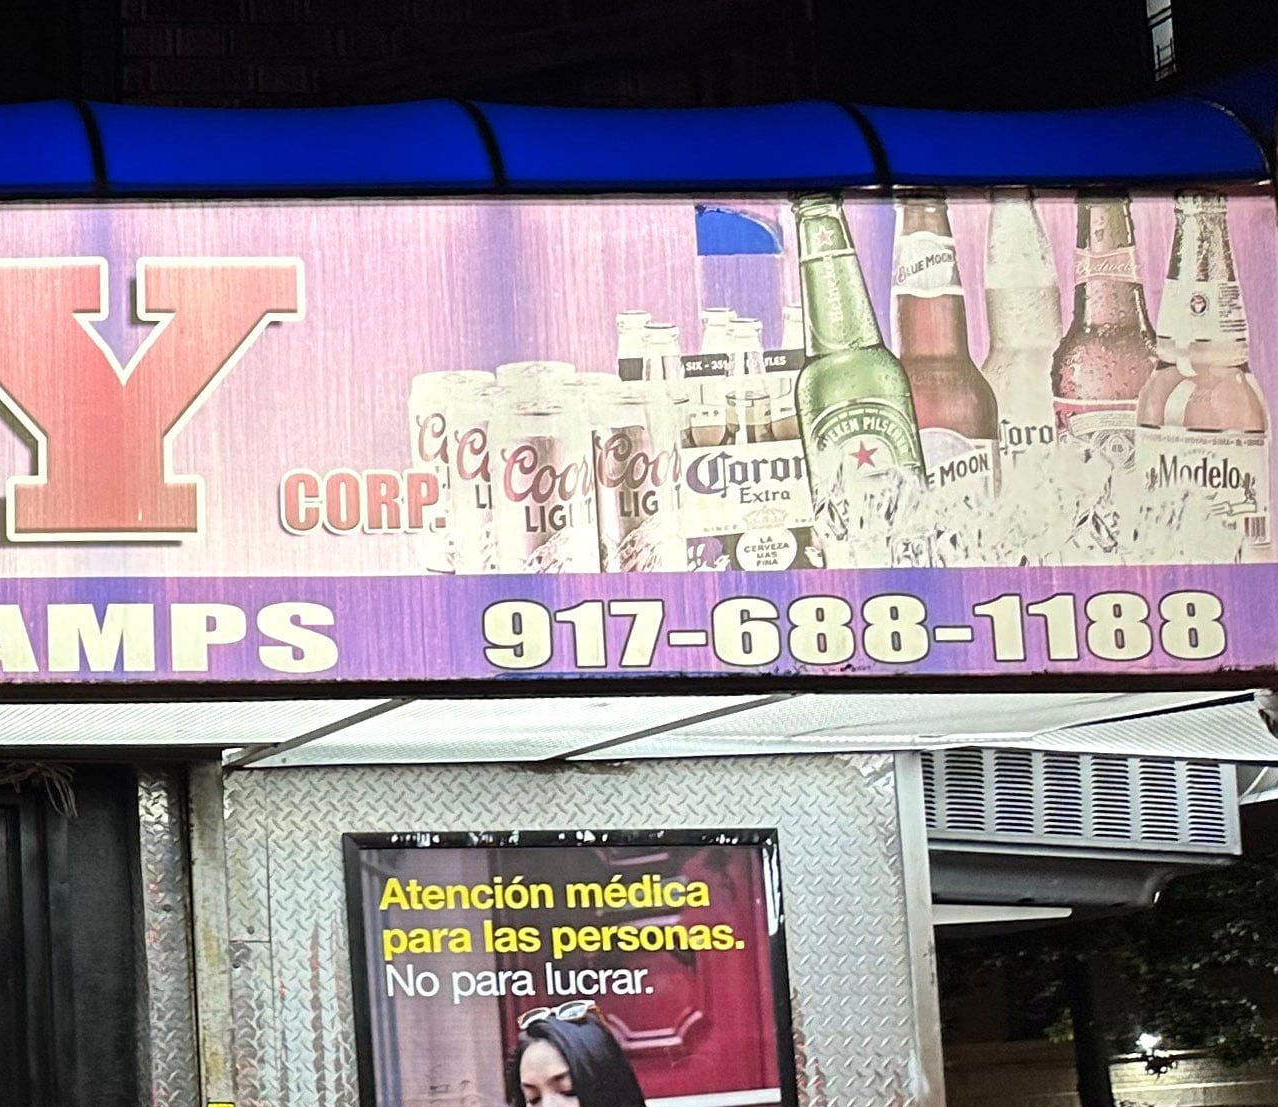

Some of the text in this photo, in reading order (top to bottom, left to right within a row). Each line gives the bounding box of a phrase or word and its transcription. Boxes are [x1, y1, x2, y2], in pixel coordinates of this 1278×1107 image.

[686, 451, 810, 498] Coron
[1159, 454, 1240, 489] Modelo
[281, 468, 446, 533] CORP.
[740, 486, 791, 504] Extra
[744, 542, 789, 553] CERVEZA
[482, 590, 1228, 671] 917-688-1188
[380, 874, 709, 911] Atención médica
[383, 920, 745, 960] para las personas.
[386, 962, 654, 1004] No para lucrar.
